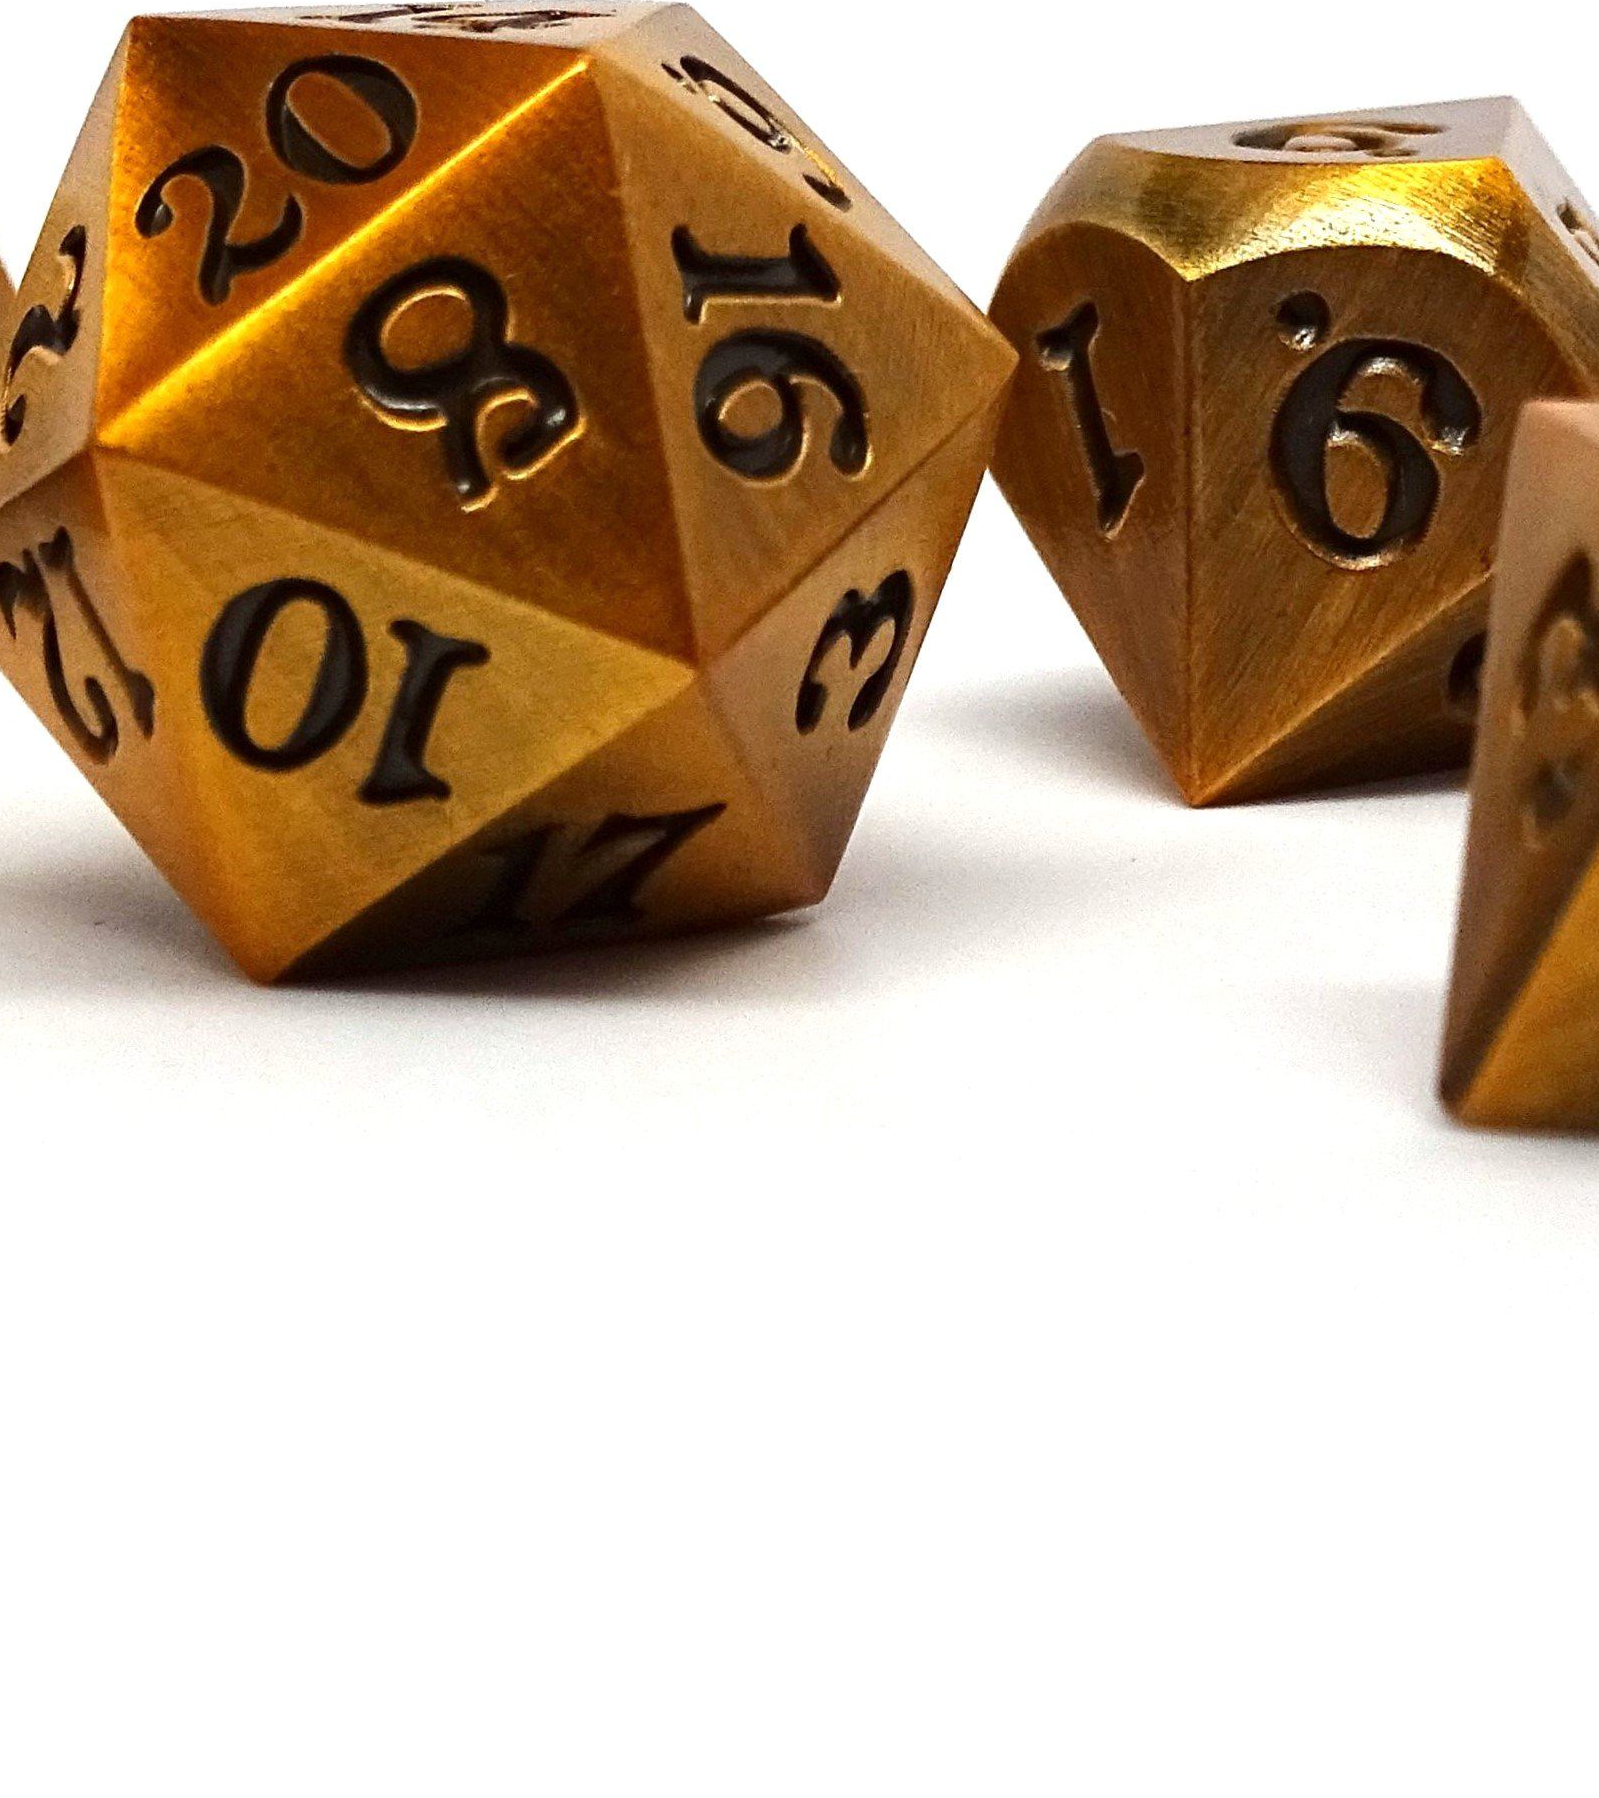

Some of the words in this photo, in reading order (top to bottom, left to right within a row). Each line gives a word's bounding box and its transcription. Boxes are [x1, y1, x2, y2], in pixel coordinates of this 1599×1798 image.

[135, 54, 420, 304] 20
[671, 222, 873, 488] 16
[1036, 296, 1145, 540] 1
[201, 576, 491, 805] 10
[795, 568, 917, 736] 3
